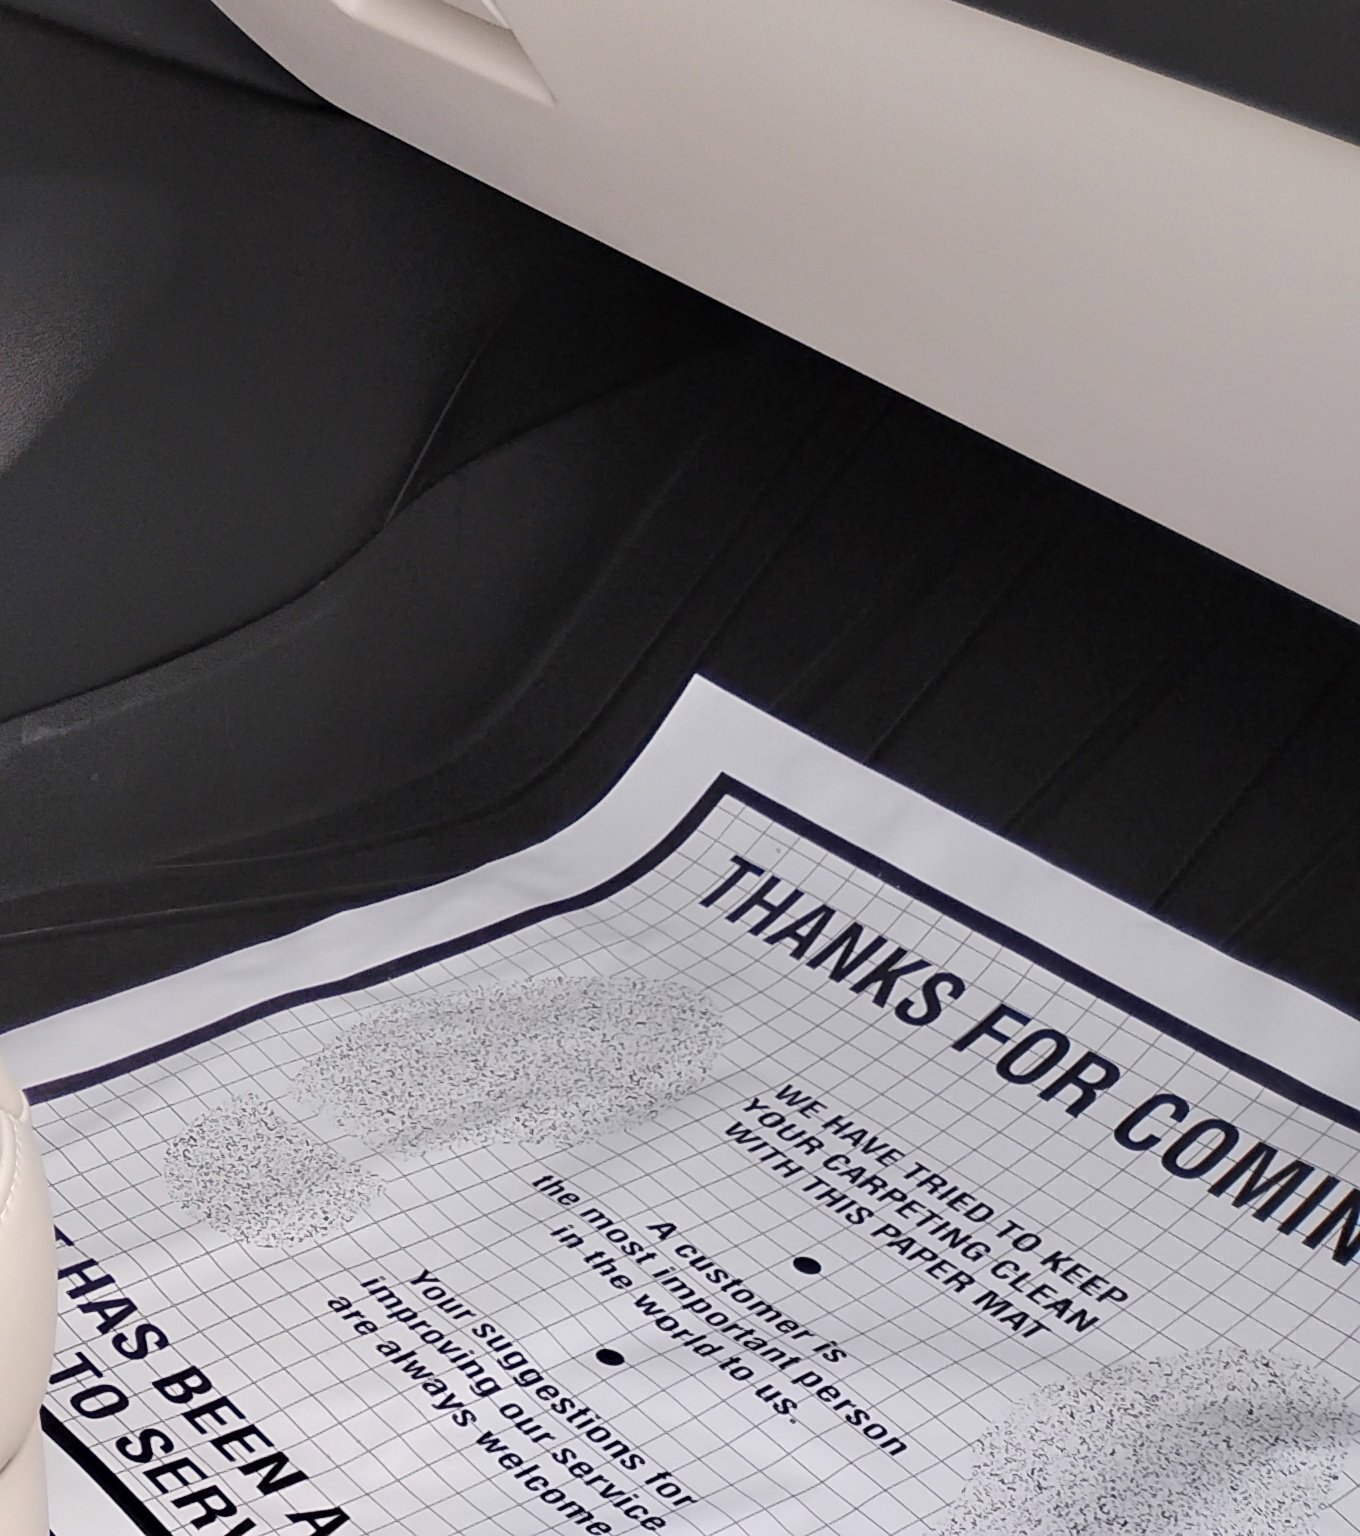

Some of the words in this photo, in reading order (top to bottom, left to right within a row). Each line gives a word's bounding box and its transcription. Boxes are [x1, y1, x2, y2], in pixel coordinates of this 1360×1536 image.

[699, 855, 965, 1026] THANKS
[952, 1003, 1121, 1118] FOR
[646, 1221, 678, 1242] A
[675, 1243, 815, 1342] customer
[813, 1340, 848, 1363] is
[724, 1121, 804, 1179] WITH
[802, 1176, 875, 1226] THIS
[871, 1223, 977, 1294] PAPER
[973, 1290, 1053, 1339] MAT
[742, 1097, 825, 1156] YOUR
[823, 1154, 992, 1262] CARPETING
[990, 1260, 1102, 1333] CLEAN
[775, 1084, 829, 1119] WE
[822, 1115, 906, 1168] HAVE
[903, 1162, 995, 1224] TRIED
[996, 1219, 1042, 1252] TO
[1040, 1249, 1129, 1308] KEEP
[49, 1351, 129, 1419] TO
[57, 1258, 169, 1360] HAS
[152, 1365, 309, 1496] BEEN
[327, 1296, 379, 1336] are
[375, 1340, 477, 1427] always
[475, 1430, 612, 1536] welcome
[360, 1276, 502, 1398] improving
[498, 1402, 556, 1444] our
[552, 1446, 666, 1532] service
[410, 1268, 477, 1321] Your
[471, 1321, 646, 1471] suggestions
[644, 1470, 699, 1507] for
[531, 1174, 582, 1207] the
[580, 1207, 657, 1265] most
[652, 1266, 802, 1371] important
[791, 1370, 908, 1457] person
[550, 1224, 584, 1249] in
[583, 1250, 633, 1290] the
[634, 1293, 724, 1358] world
[719, 1356, 756, 1382] to
[754, 1383, 798, 1425] us.
